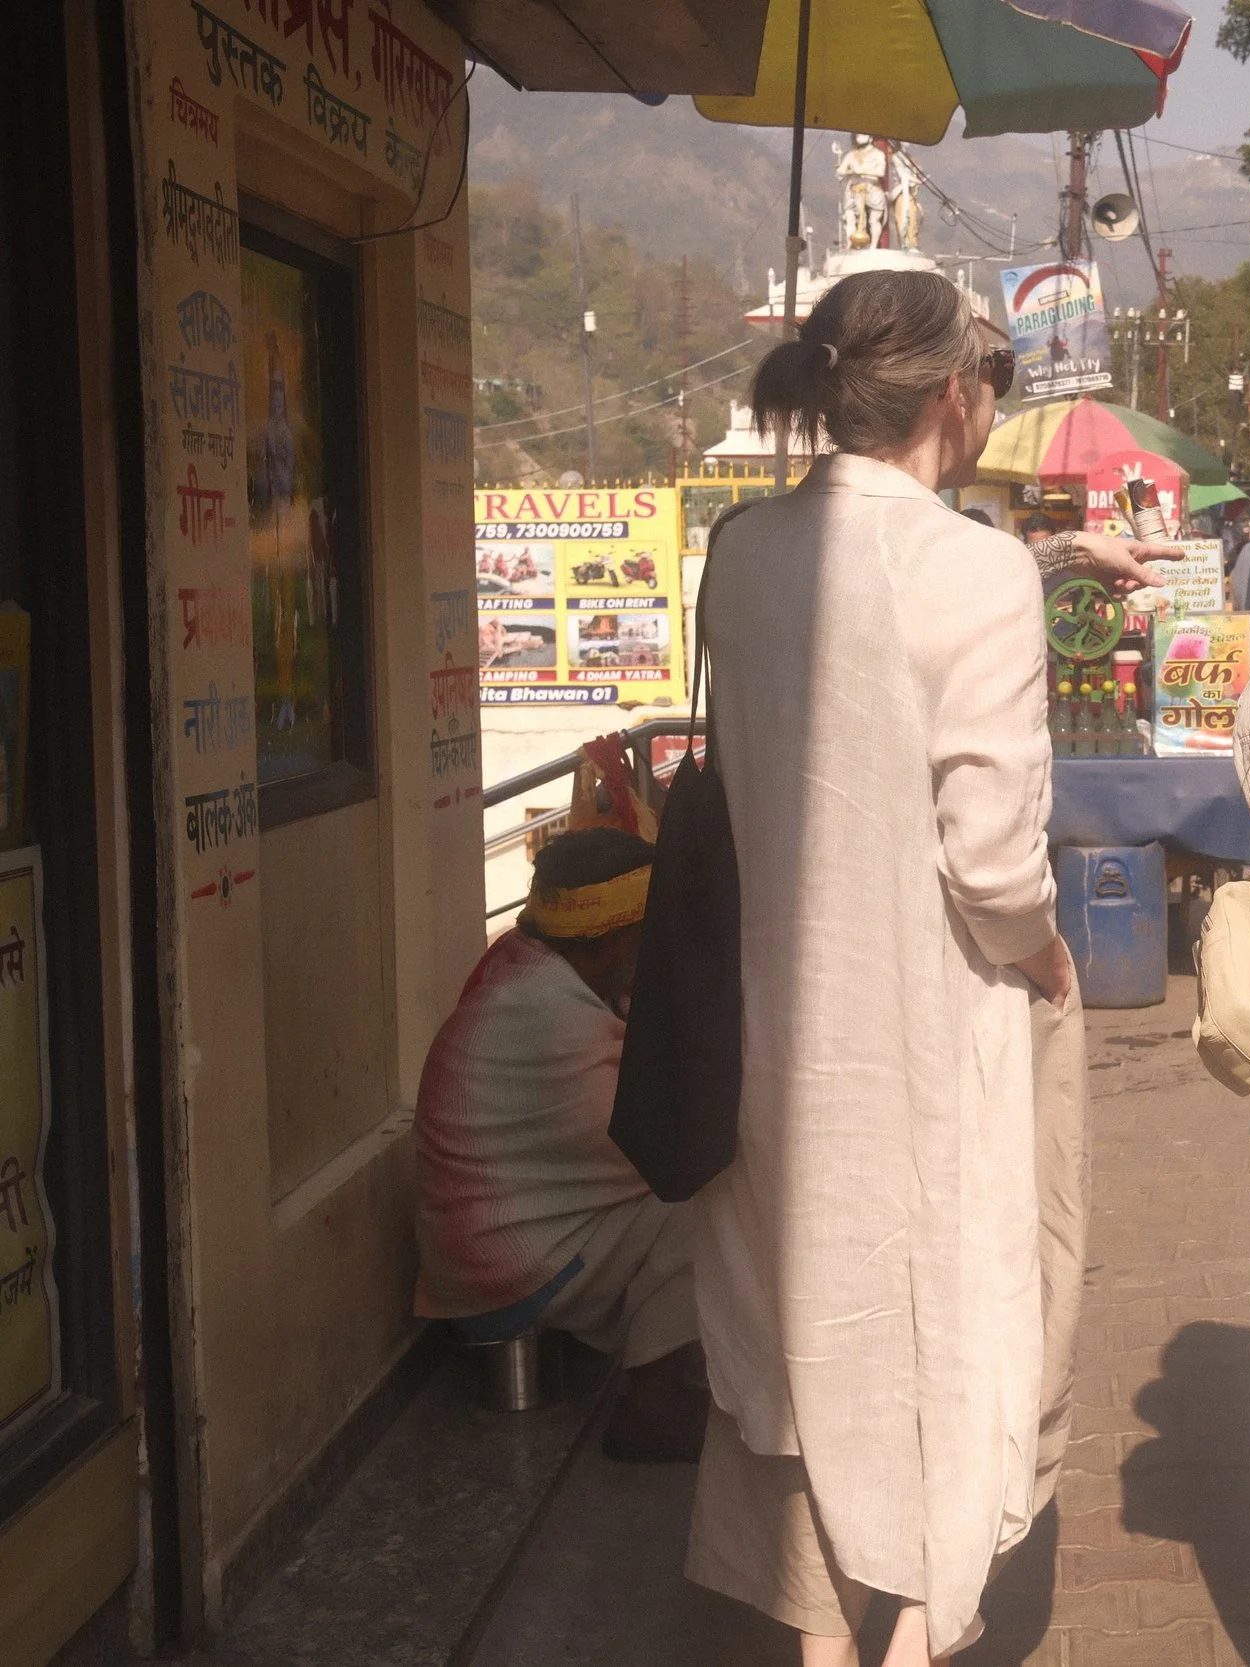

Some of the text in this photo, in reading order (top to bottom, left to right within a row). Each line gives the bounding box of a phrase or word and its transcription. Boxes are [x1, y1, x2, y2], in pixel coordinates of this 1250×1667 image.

[190, 0, 287, 107] पुस्तक
[303, 63, 371, 157] विक्रय
[1016, 294, 1096, 337] PARAGLIDING
[474, 491, 658, 521] RAVELS
[1160, 566, 1219, 576] Sweet Lime
[579, 597, 656, 609] BIKE ON RENT
[576, 670, 663, 681] 4 DHAM YATRA
[1162, 650, 1243, 686] बर्फ
[480, 687, 507, 703] ita
[509, 687, 589, 702] Bhawan
[1203, 690, 1222, 701] का
[1160, 698, 1239, 730] गोल
